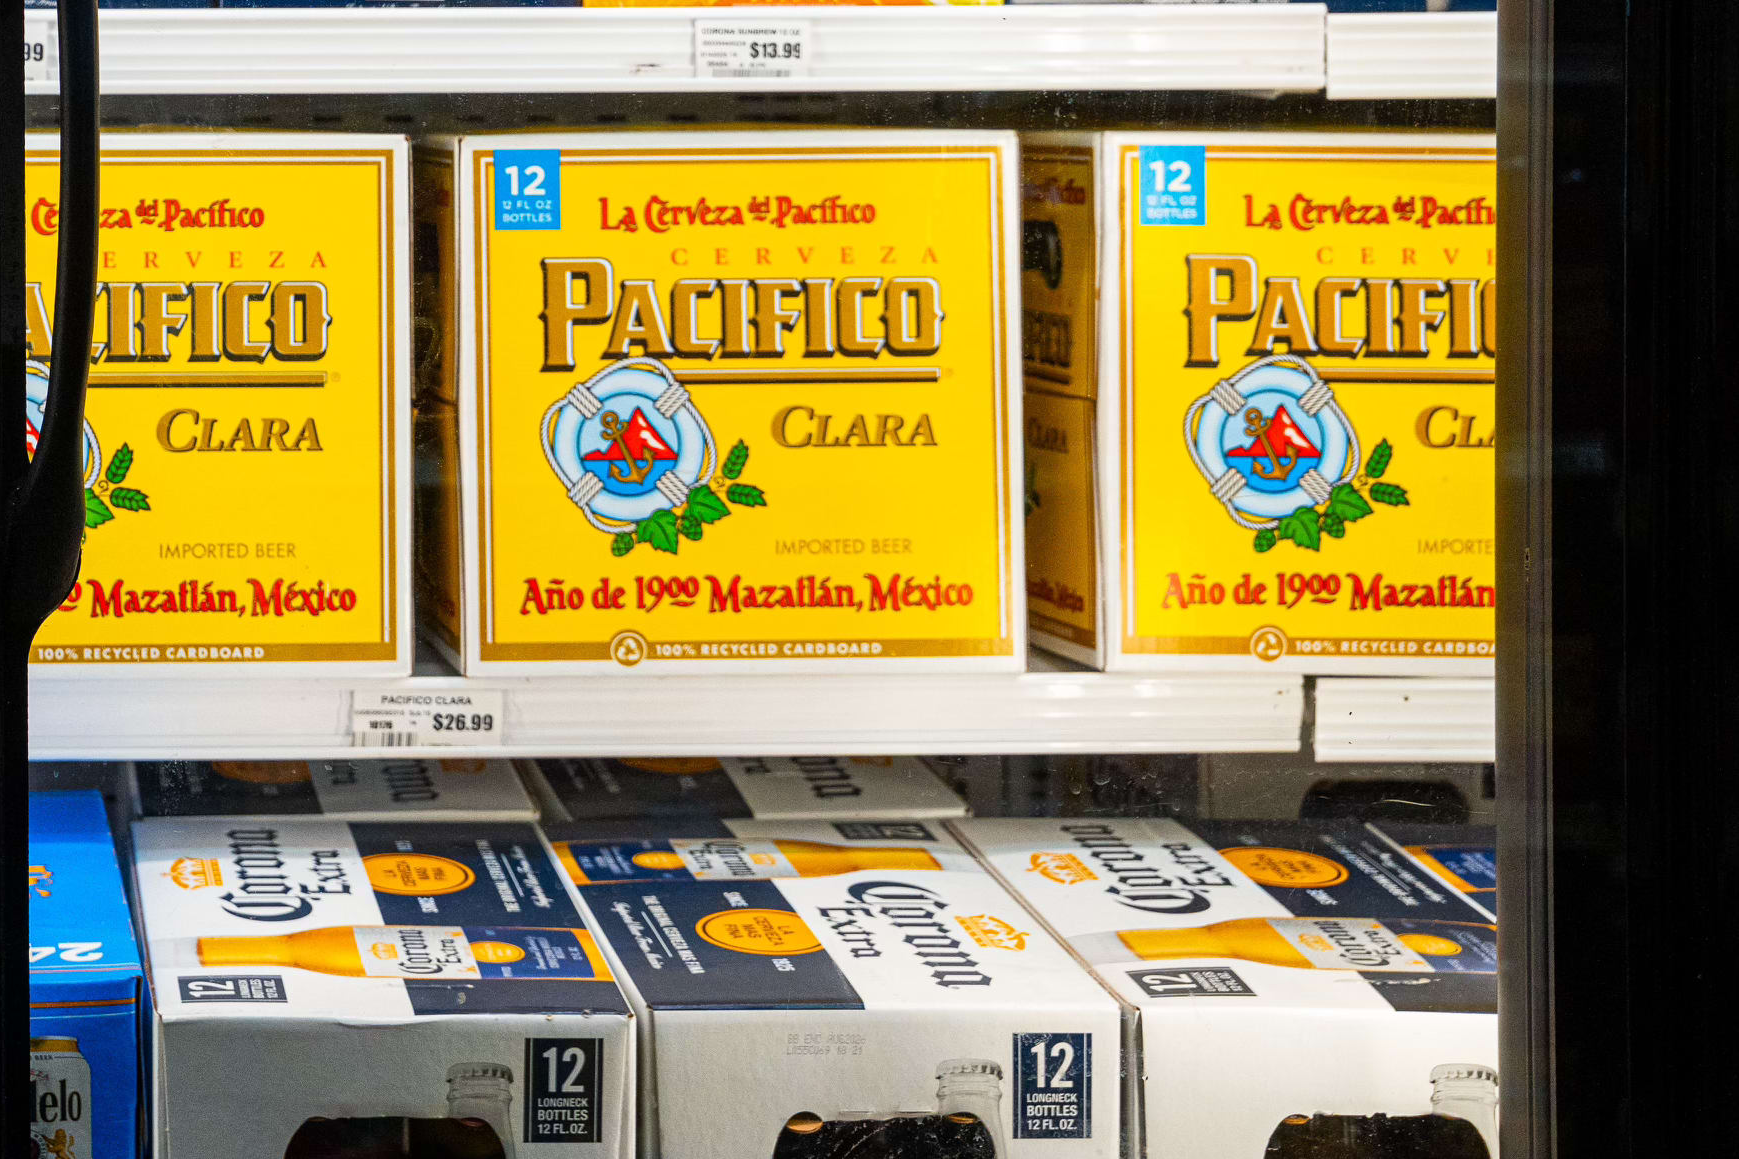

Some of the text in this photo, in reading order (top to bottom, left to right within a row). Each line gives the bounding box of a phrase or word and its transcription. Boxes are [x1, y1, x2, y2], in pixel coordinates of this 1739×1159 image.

[750, 43, 800, 58] $13.99
[504, 165, 546, 196] 12
[1149, 161, 1192, 192] 12
[503, 213, 552, 223] BOTTLES
[599, 198, 638, 232] La
[102, 250, 327, 269] ERVEZA
[671, 247, 939, 265] CERVEZA
[539, 257, 945, 372] PACIFICO
[1183, 254, 1495, 368] PACIFI
[156, 409, 323, 452] CLARA
[771, 406, 937, 447] CLARA
[159, 542, 296, 559] IMPORTED BEER
[519, 578, 585, 615] Año
[592, 578, 627, 610] de
[635, 576, 699, 612] 1900
[867, 574, 973, 612] México
[37, 646, 265, 659] 100% RECYCLED CARDBOARD
[655, 642, 882, 655] 100% RECYCLED CARDBOARD
[381, 696, 472, 704] PACIFICO CLARA
[433, 714, 493, 731] $26.99
[220, 827, 313, 922] Corona
[310, 848, 351, 901] Extra
[1062, 825, 1211, 914] Corona
[817, 900, 882, 958] Extra
[848, 880, 993, 989] Corona
[542, 1047, 584, 1093] 12
[1030, 1041, 1074, 1088] 12
[537, 1098, 588, 1107] LONGNECK
[1027, 1093, 1077, 1103] LONGNECK
[1027, 1106, 1077, 1117] BOTTLES
[537, 1109, 589, 1121] BOTTLES
[538, 1124, 551, 1134] 12
